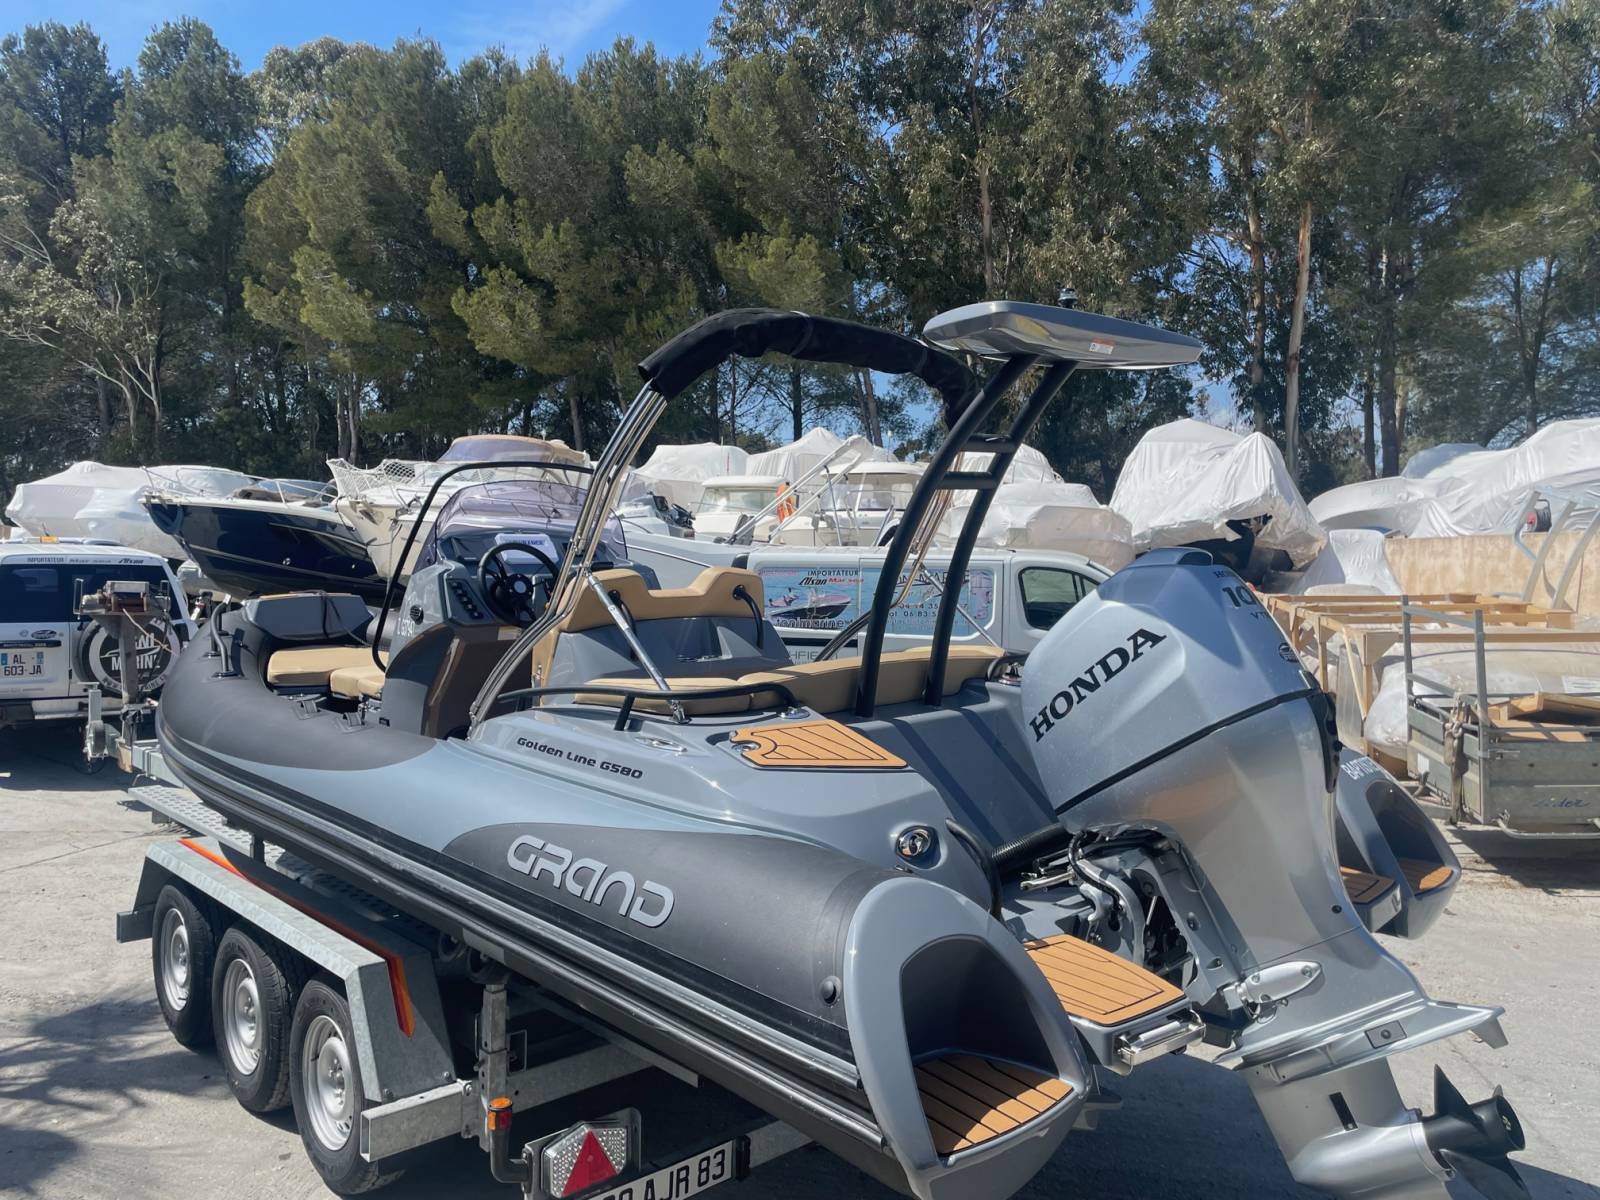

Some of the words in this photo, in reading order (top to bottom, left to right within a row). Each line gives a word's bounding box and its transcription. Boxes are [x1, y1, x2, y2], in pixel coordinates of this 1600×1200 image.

[807, 569, 859, 577] IMPORTATEUR
[4, 665, 25, 676] 603
[28, 665, 42, 675] JA
[13, 654, 26, 665] AL
[1028, 628, 1167, 742] HONDA
[517, 737, 563, 758] Golden
[566, 751, 597, 767] Line
[599, 761, 643, 779] G580
[506, 834, 675, 928] GRAND
[643, 1165, 690, 1200] AJR
[697, 1148, 726, 1188] 83
